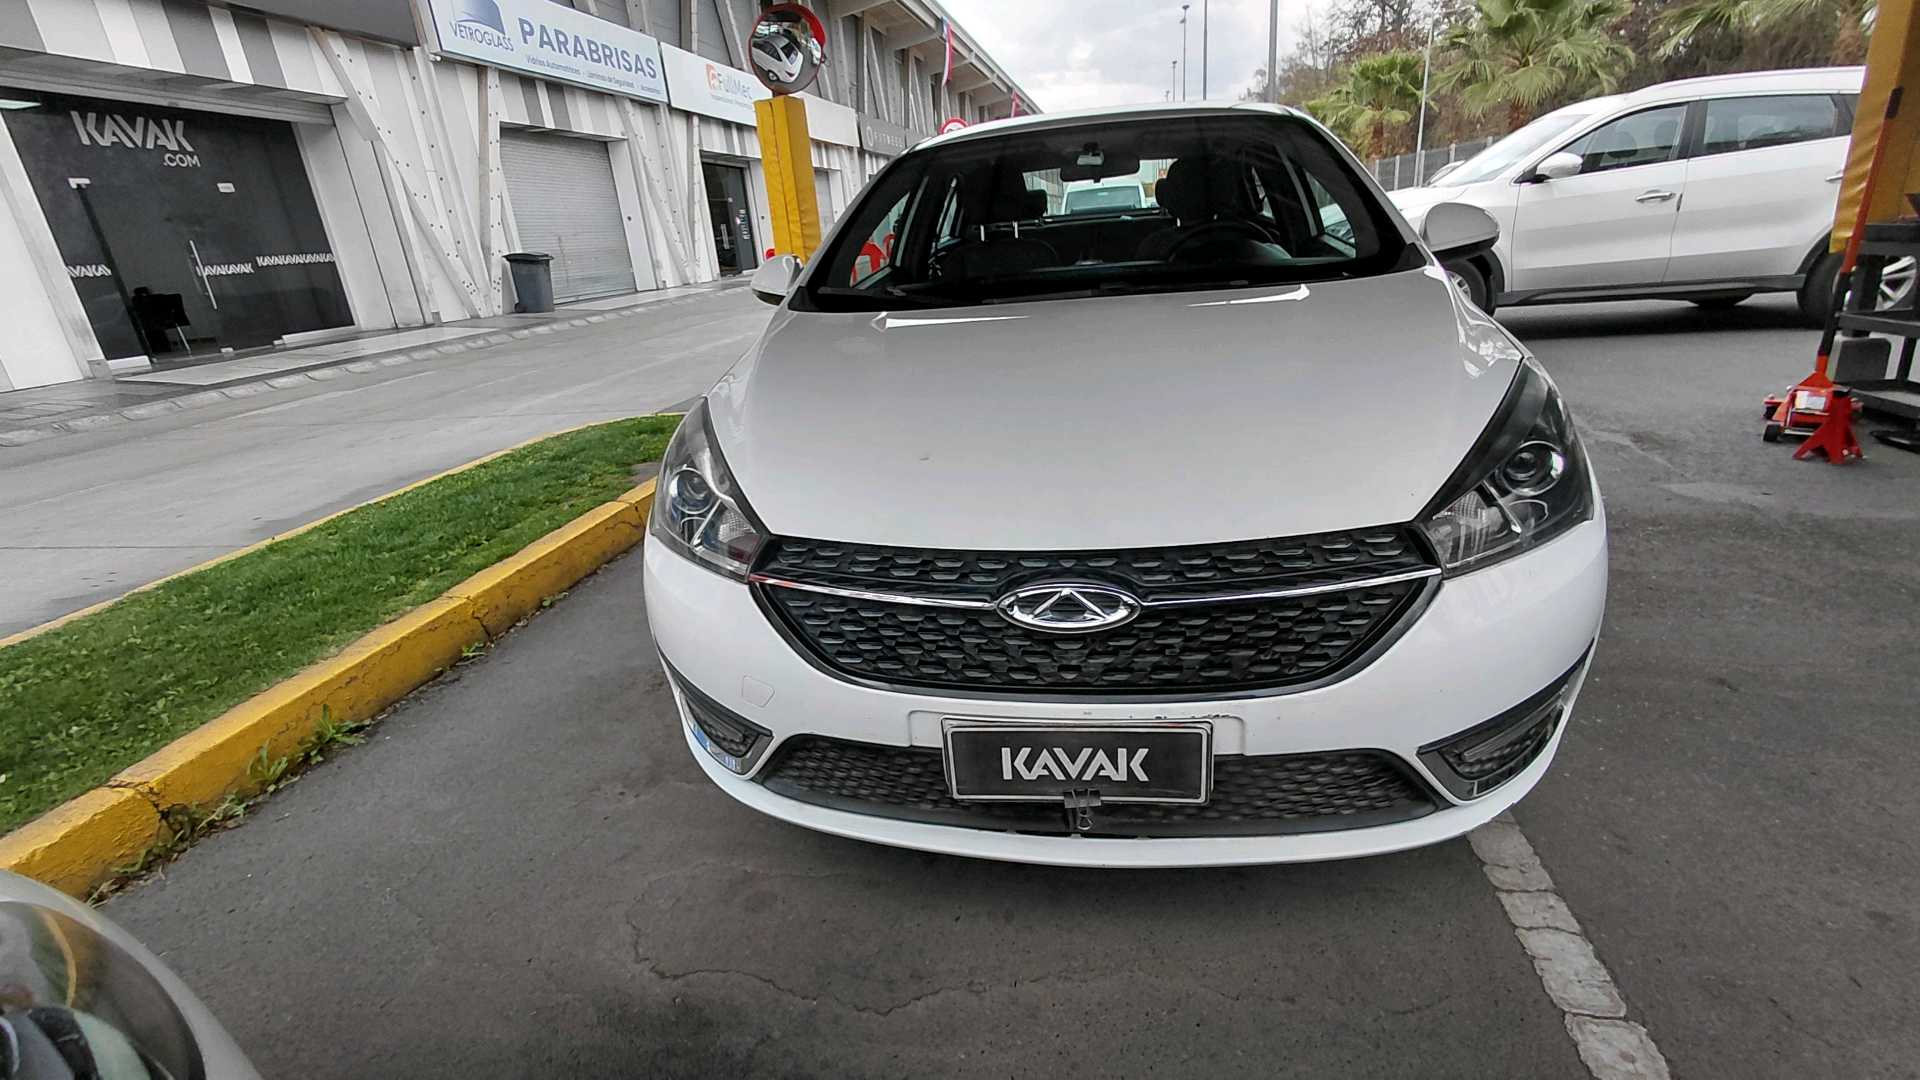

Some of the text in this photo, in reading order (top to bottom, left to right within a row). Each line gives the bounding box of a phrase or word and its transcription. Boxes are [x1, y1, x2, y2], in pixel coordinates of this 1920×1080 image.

[449, 22, 514, 51] VETROGLASS
[518, 17, 657, 79] PARABRISAS
[70, 110, 195, 151] KAVAK
[163, 153, 200, 167] .COM
[1001, 747, 1149, 782] KAVAK
